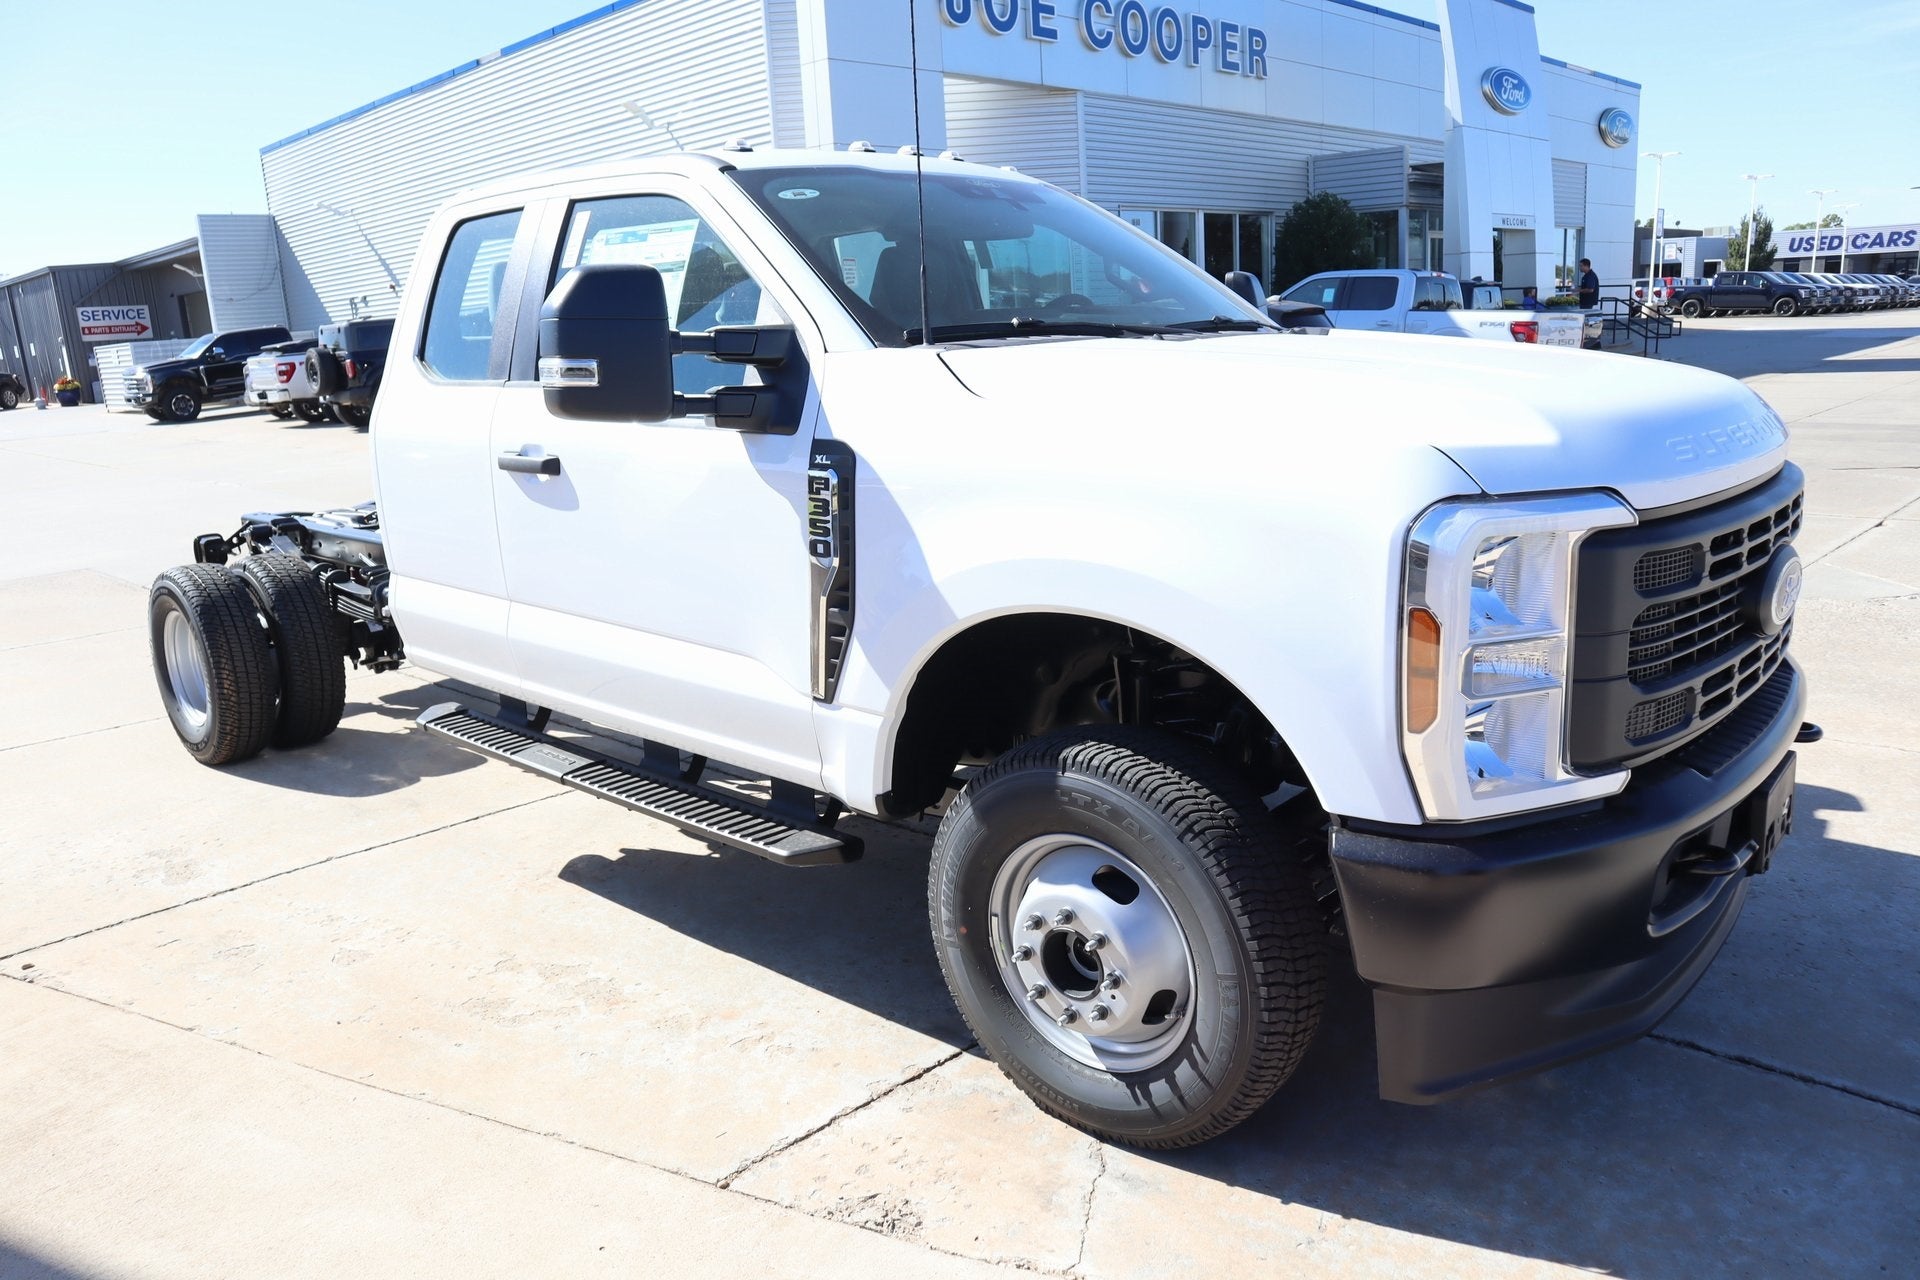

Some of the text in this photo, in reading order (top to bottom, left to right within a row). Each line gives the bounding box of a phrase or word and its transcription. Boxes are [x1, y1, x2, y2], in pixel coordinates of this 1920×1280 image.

[1081, 0, 1268, 79] COOPER
[1501, 75, 1526, 103] Ford
[1501, 217, 1527, 227] WELCOME
[1788, 230, 1918, 253] USED CARS
[80, 308, 147, 322] SERVICE
[90, 326, 110, 334] PARTS
[111, 324, 142, 333] ENTRANCE
[814, 454, 831, 464] XL
